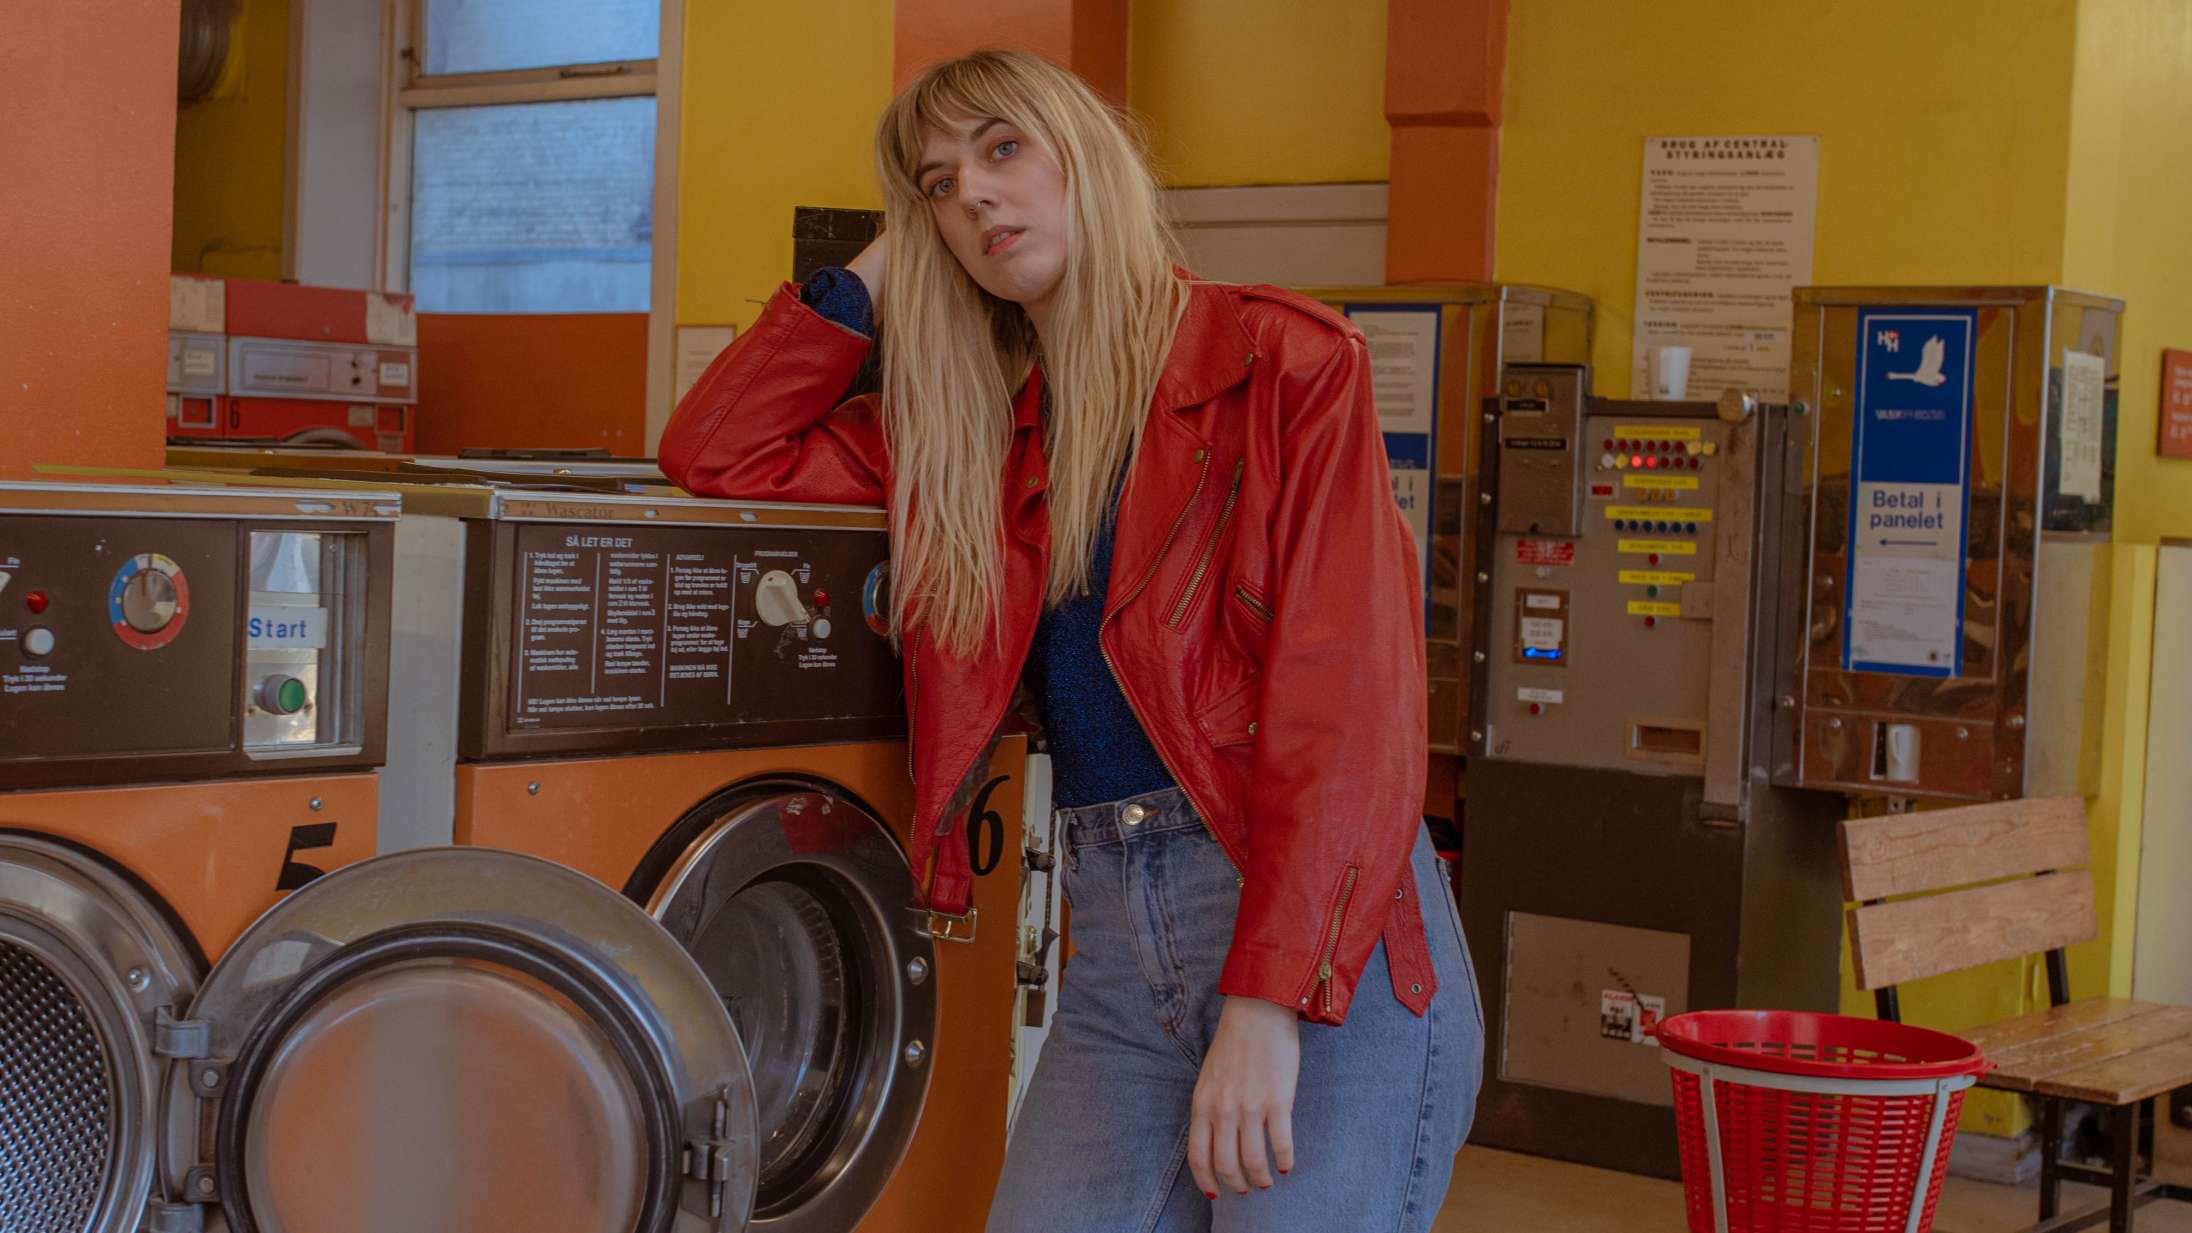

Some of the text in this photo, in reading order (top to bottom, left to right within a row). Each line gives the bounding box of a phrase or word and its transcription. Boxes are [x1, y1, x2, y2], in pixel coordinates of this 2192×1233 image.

[1661, 140, 1696, 149] BRUG
[1872, 490, 1941, 509] Betal i
[1869, 512, 1944, 531] panelet
[565, 535, 633, 548] SÅ LET ER DET
[247, 617, 307, 639] Start
[966, 774, 1010, 876] 6
[275, 822, 337, 892] 5
